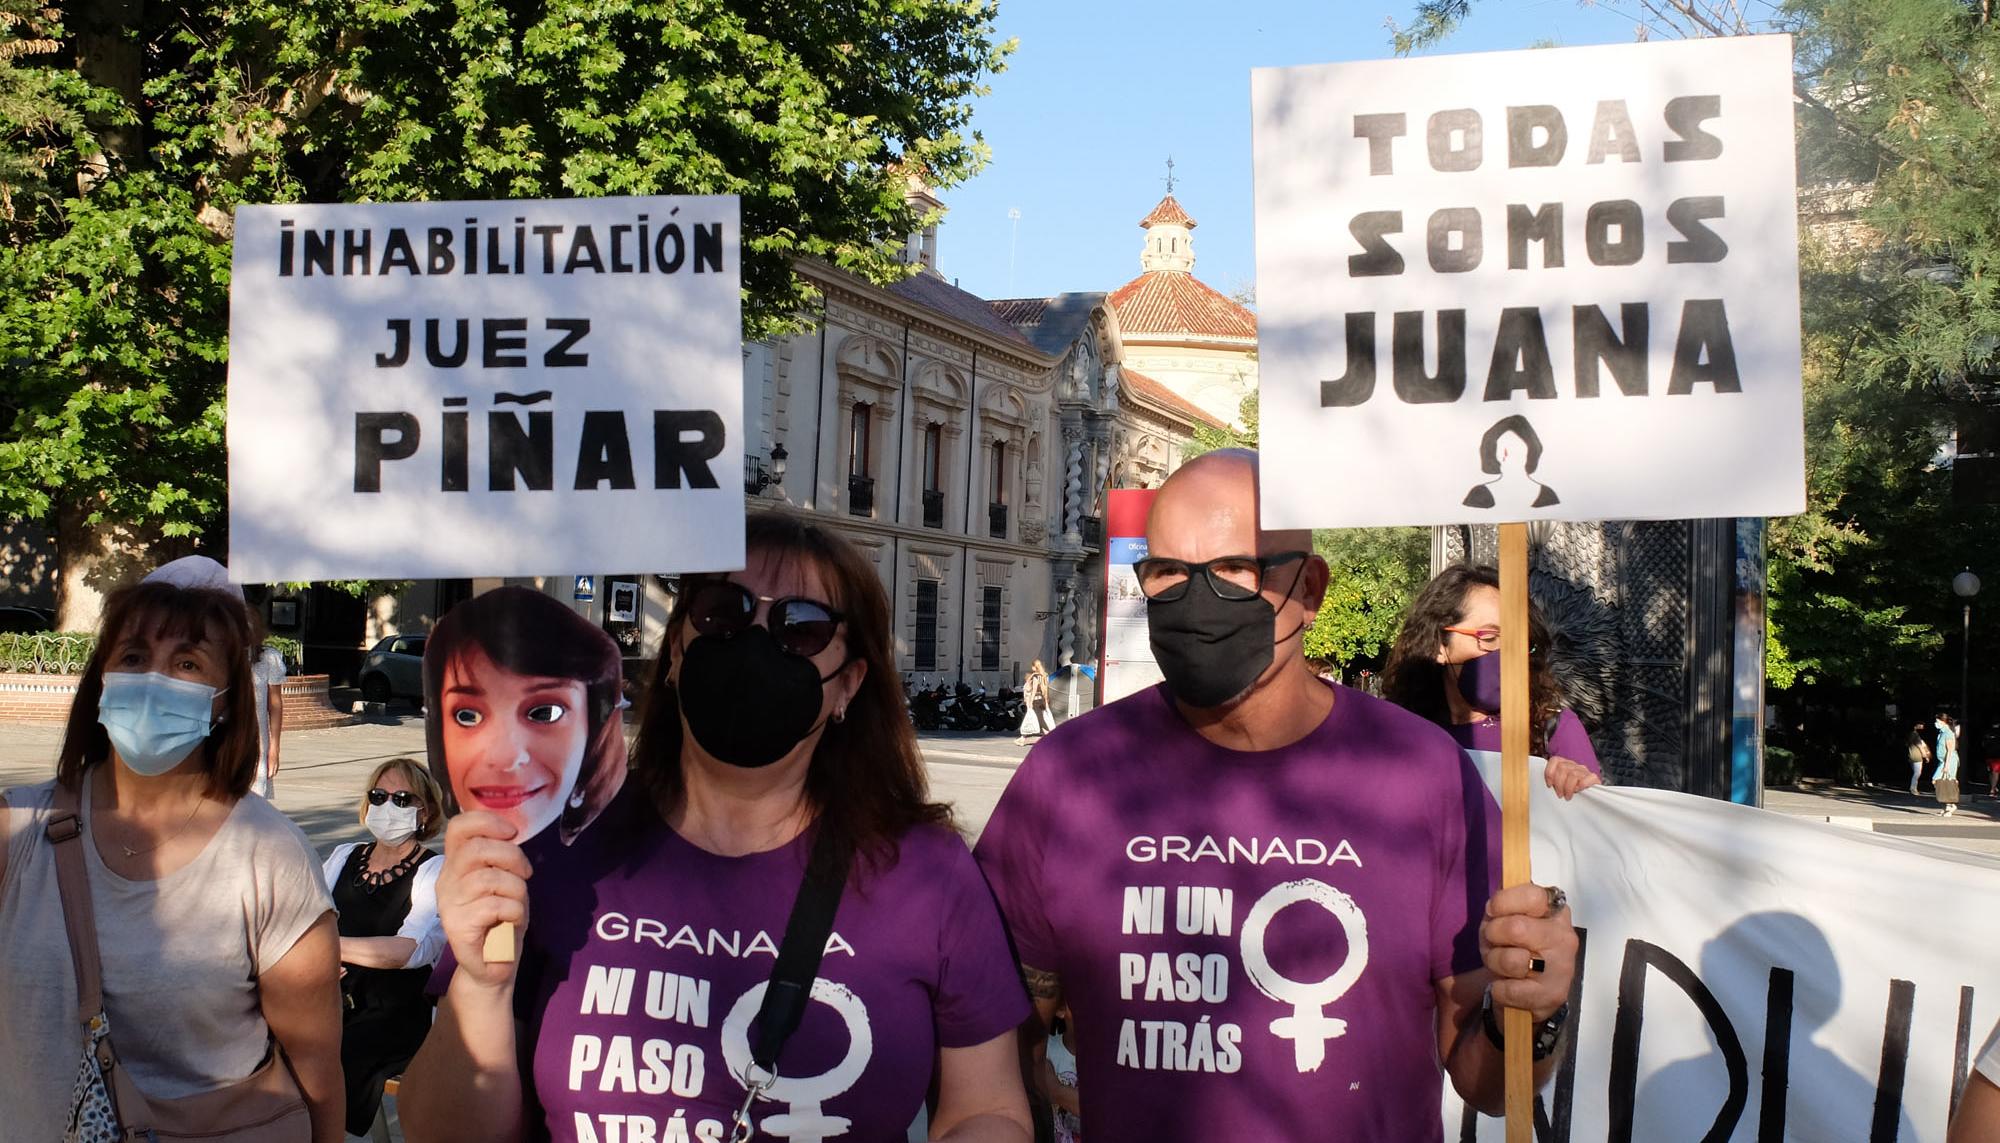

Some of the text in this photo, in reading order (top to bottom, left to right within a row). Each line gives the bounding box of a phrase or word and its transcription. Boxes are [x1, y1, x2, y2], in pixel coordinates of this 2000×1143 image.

[1353, 94, 1724, 176] TODAS
[1347, 196, 1728, 277] SOMOS
[375, 318, 591, 368] JUEZ
[1320, 298, 1743, 408] JUANA
[1126, 835, 1363, 867] GRANADA
[596, 912, 855, 959] GRANAA
[1122, 886, 1233, 937] NI UN
[580, 965, 711, 1028] NI UN
[1119, 952, 1229, 1004] PASO
[568, 1034, 705, 1098] PASO
[1116, 1015, 1242, 1073] ATRÁS
